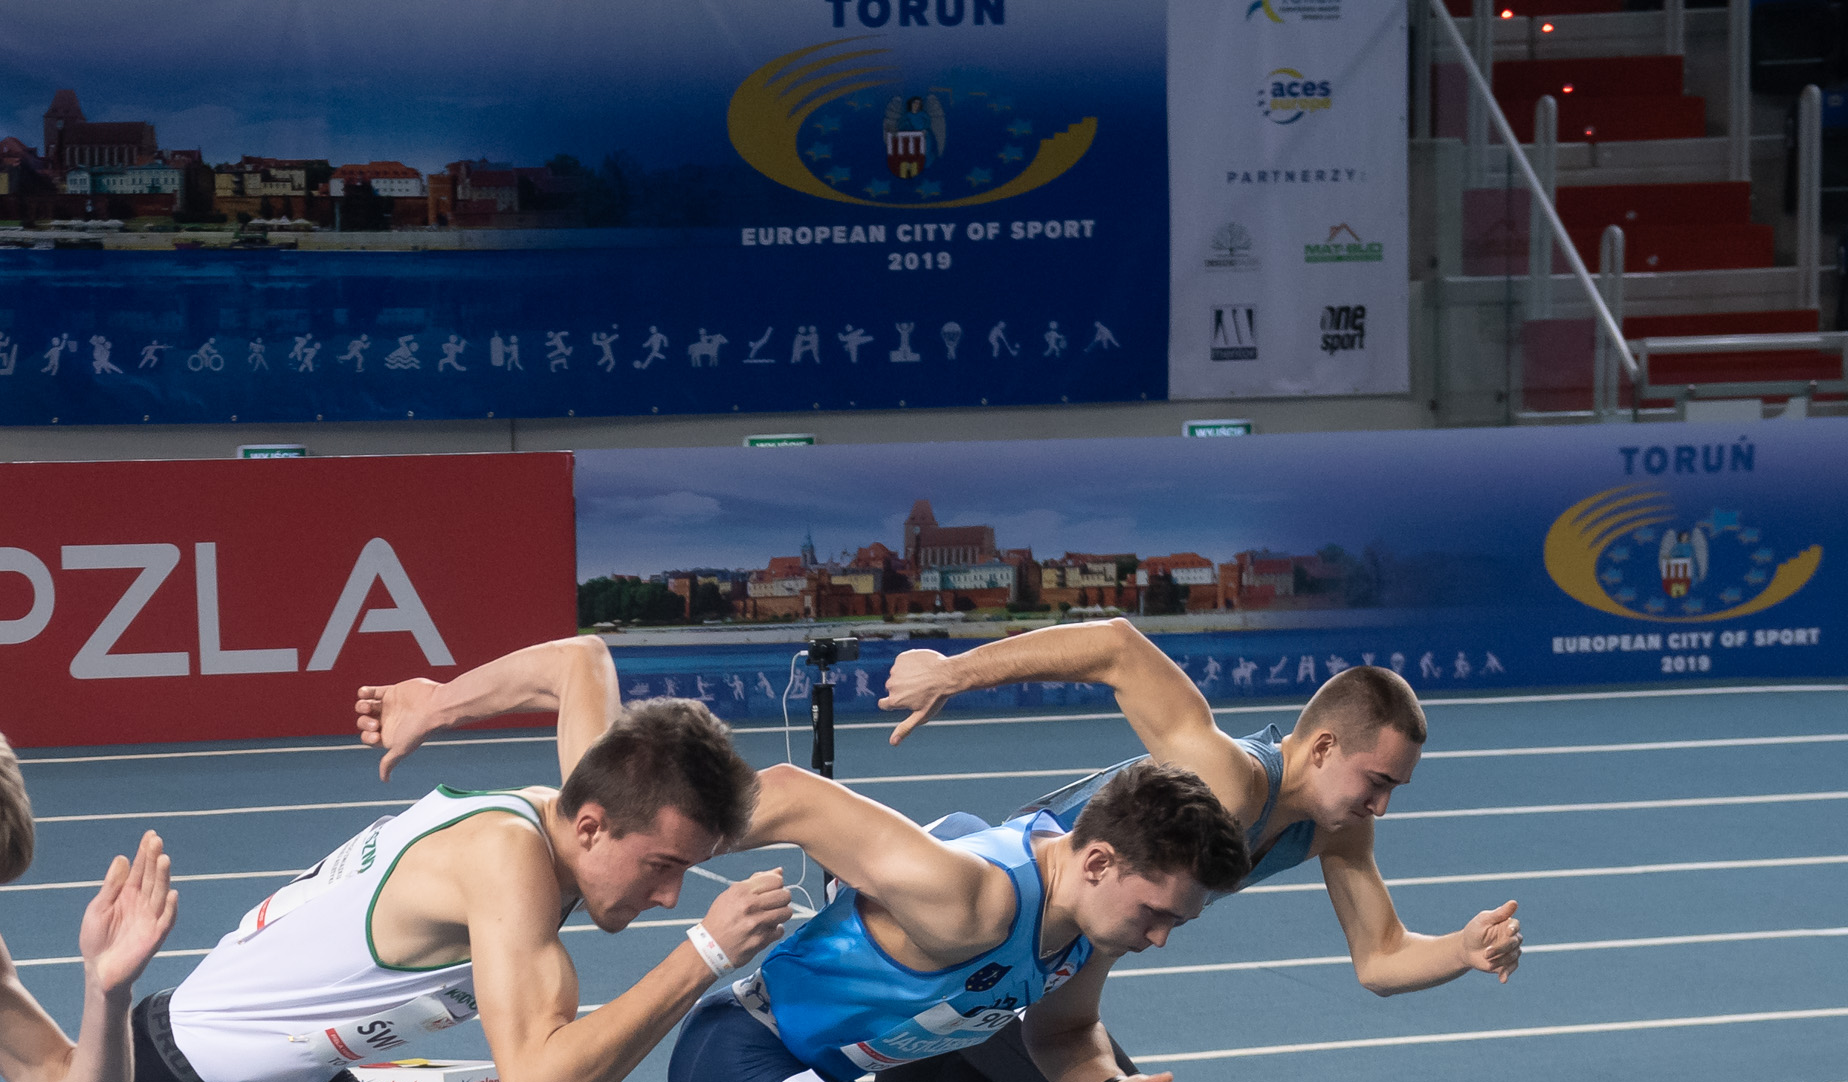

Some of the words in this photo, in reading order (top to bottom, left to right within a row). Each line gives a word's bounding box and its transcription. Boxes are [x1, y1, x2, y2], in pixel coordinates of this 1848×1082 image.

[1271, 81, 1332, 97] aces
[742, 224, 886, 246] EUROPEAN
[896, 223, 955, 242] CITY
[967, 222, 1001, 240] OF
[1010, 220, 1095, 240] SPORT
[887, 252, 952, 271] 2019
[1619, 434, 1756, 476] TORUŃ
[1552, 633, 1663, 653] EUROPEAN
[1666, 631, 1715, 649] CITY
[1719, 630, 1749, 647] OF
[1753, 627, 1821, 646] SPORT
[1660, 654, 1712, 672] 2019
